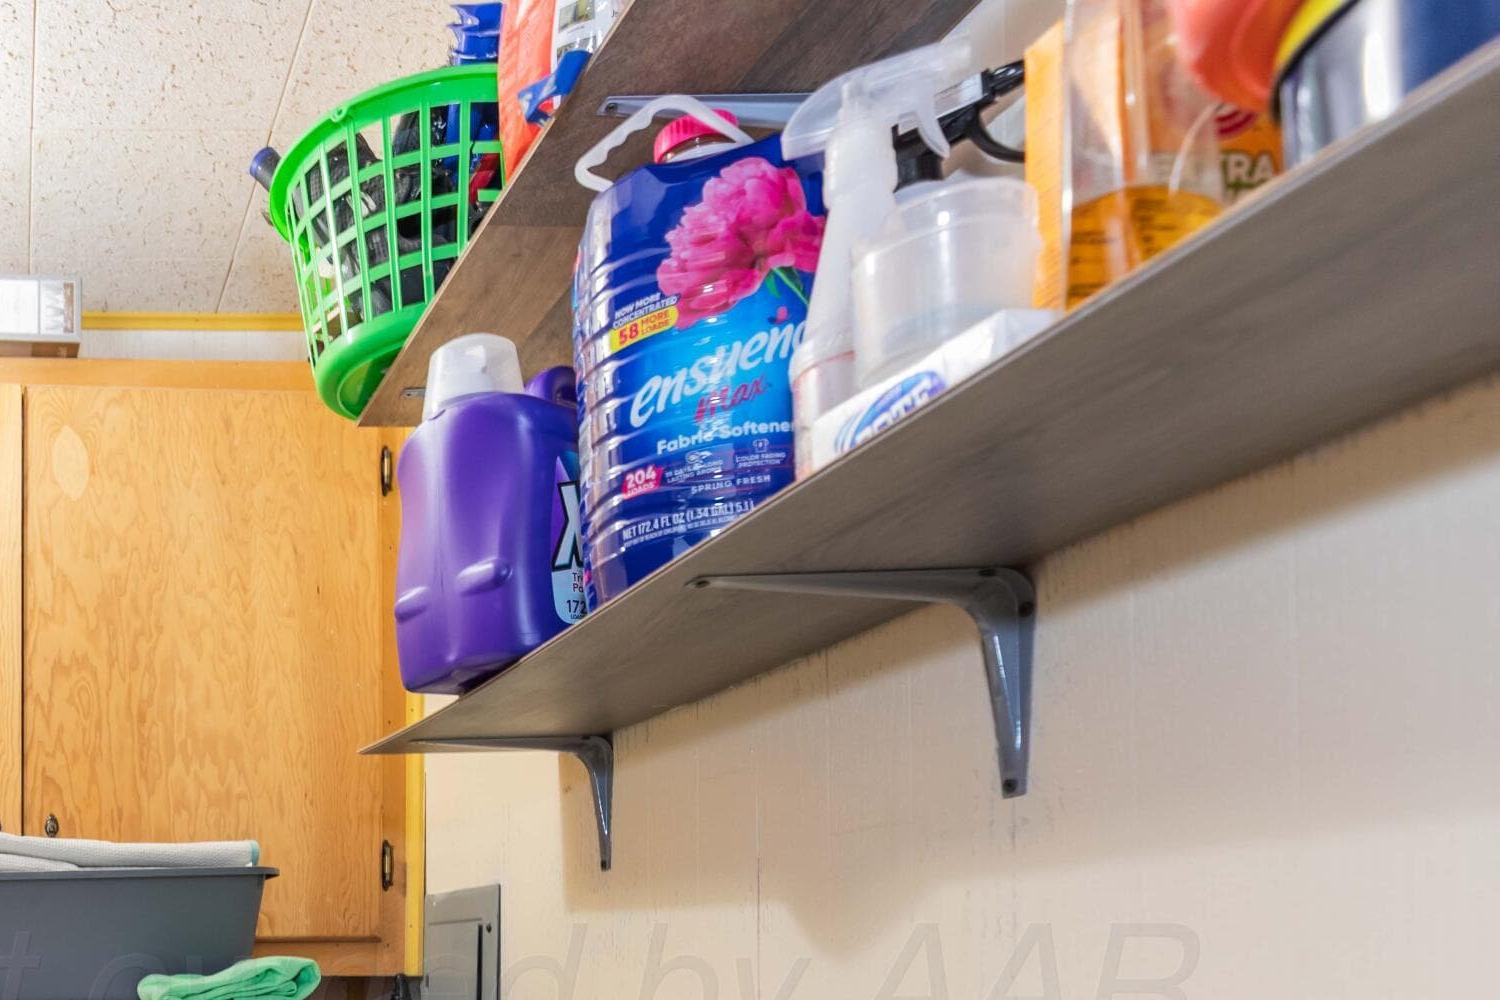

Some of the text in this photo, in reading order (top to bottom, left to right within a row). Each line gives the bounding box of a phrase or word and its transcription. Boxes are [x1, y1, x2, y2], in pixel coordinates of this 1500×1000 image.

[613, 296, 678, 329] CONCENTRATED
[615, 293, 661, 319] NOW MORE
[641, 311, 670, 327] MORE
[618, 323, 640, 345] 58
[657, 431, 715, 455] Fabric
[625, 465, 658, 488] 204
[691, 474, 771, 495] SPRING FRESH
[627, 482, 656, 497] LOADS
[622, 528, 637, 541] NET
[637, 520, 660, 537] 172.4
[660, 517, 671, 530] FL
[672, 512, 686, 525] OZ
[566, 599, 587, 614] 172
